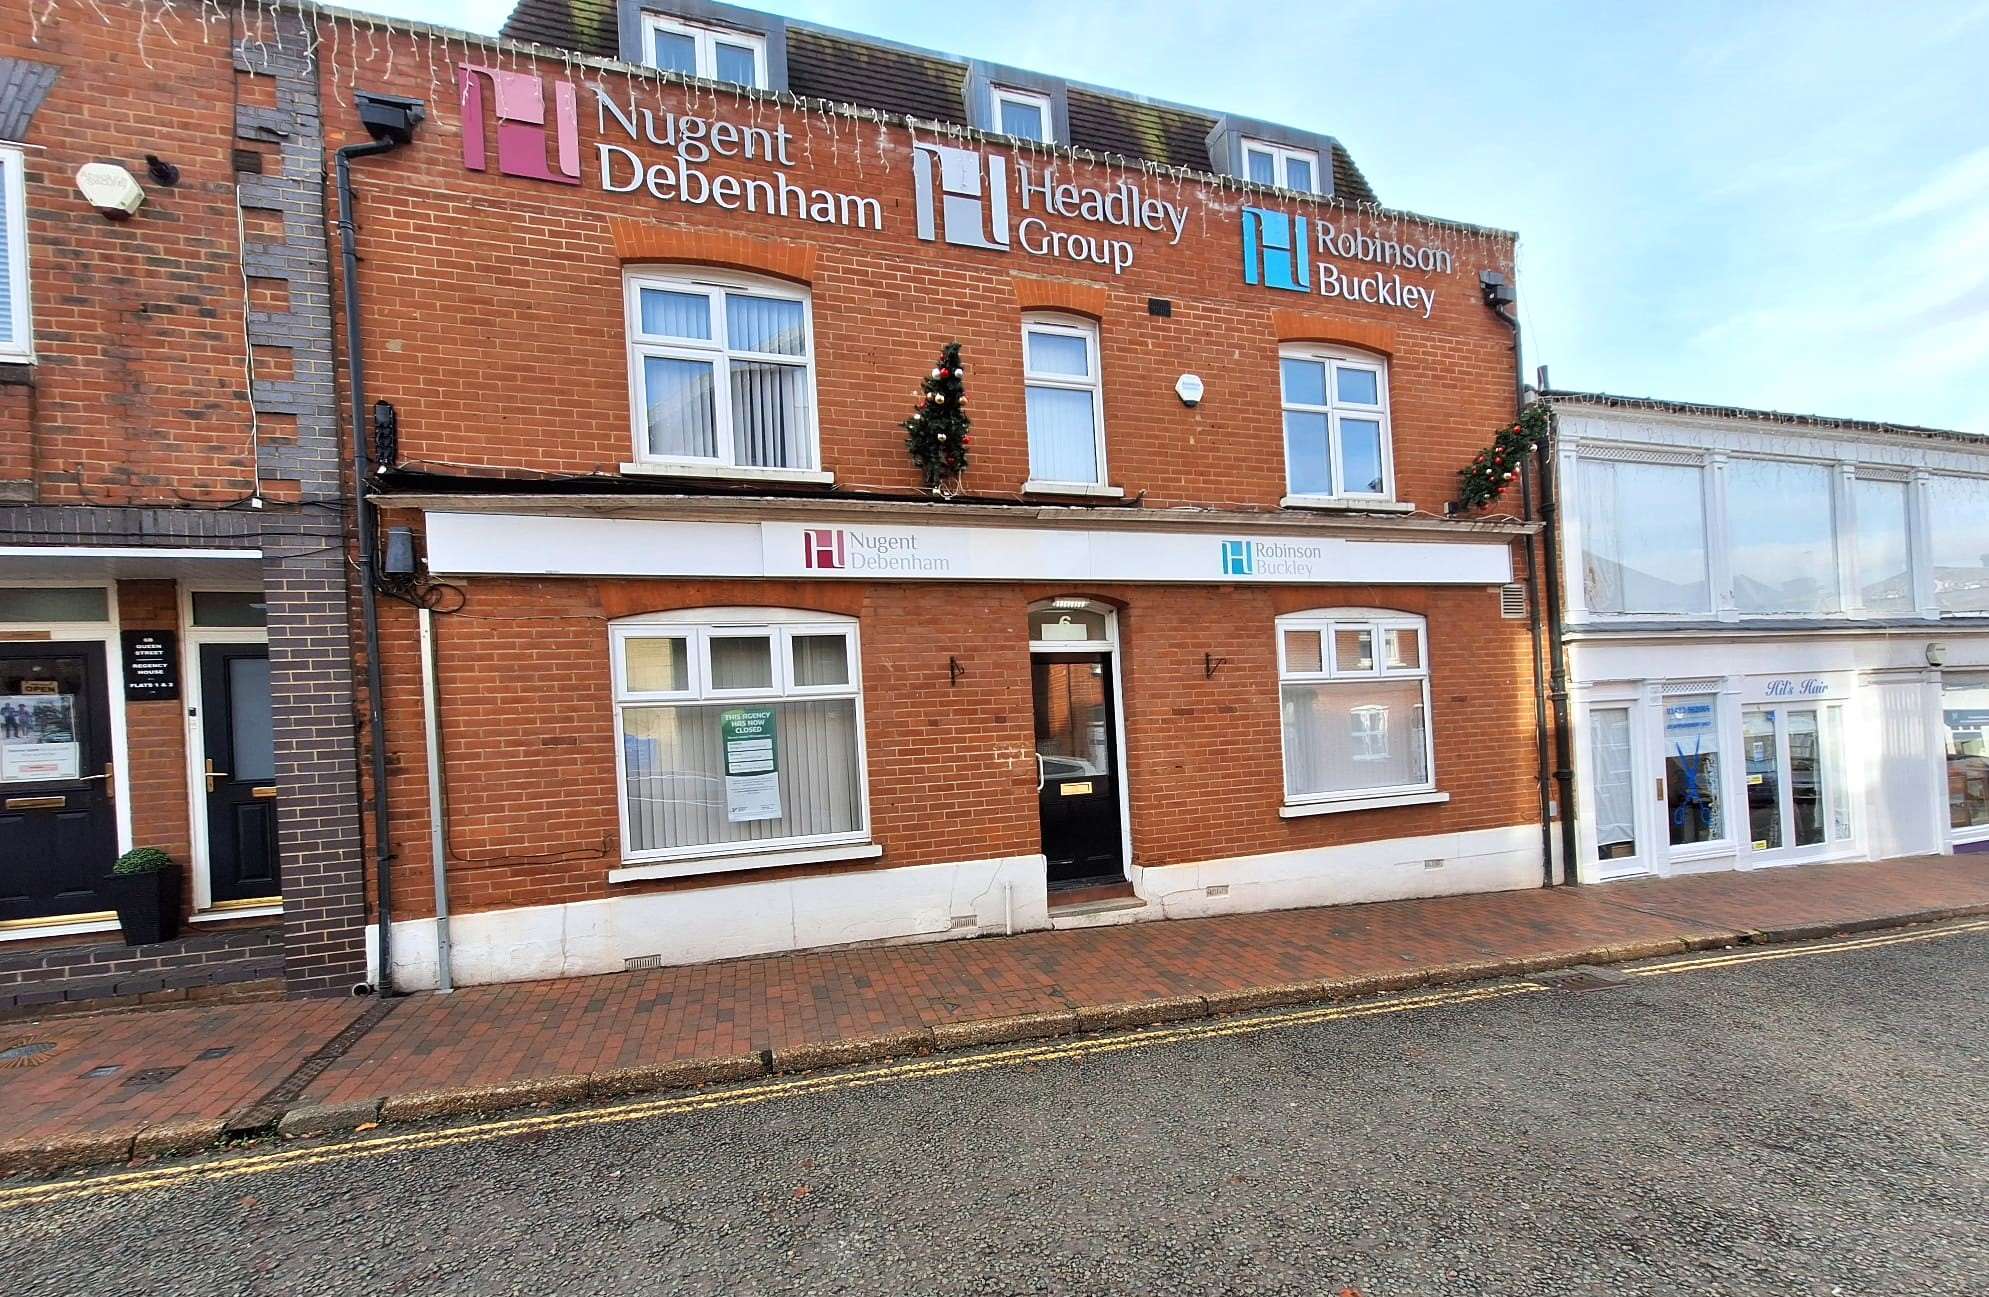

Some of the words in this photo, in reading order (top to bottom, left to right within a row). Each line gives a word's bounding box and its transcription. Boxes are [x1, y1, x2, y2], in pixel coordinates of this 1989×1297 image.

[593, 87, 795, 166] Nugent
[594, 143, 882, 230] Debenham
[1017, 162, 1188, 245] Headley
[1018, 217, 1133, 274] Group
[1316, 220, 1452, 274] Robinson
[1317, 262, 1435, 319] Buckley
[850, 532, 917, 553] Nugent
[851, 552, 949, 570] Debenham
[1256, 542, 1321, 558] Robinson
[1257, 559, 1313, 577] Buckley
[1765, 679, 1793, 696] Hil's
[1799, 678, 1828, 695] Hair
[743, 711, 771, 719] AGENCY
